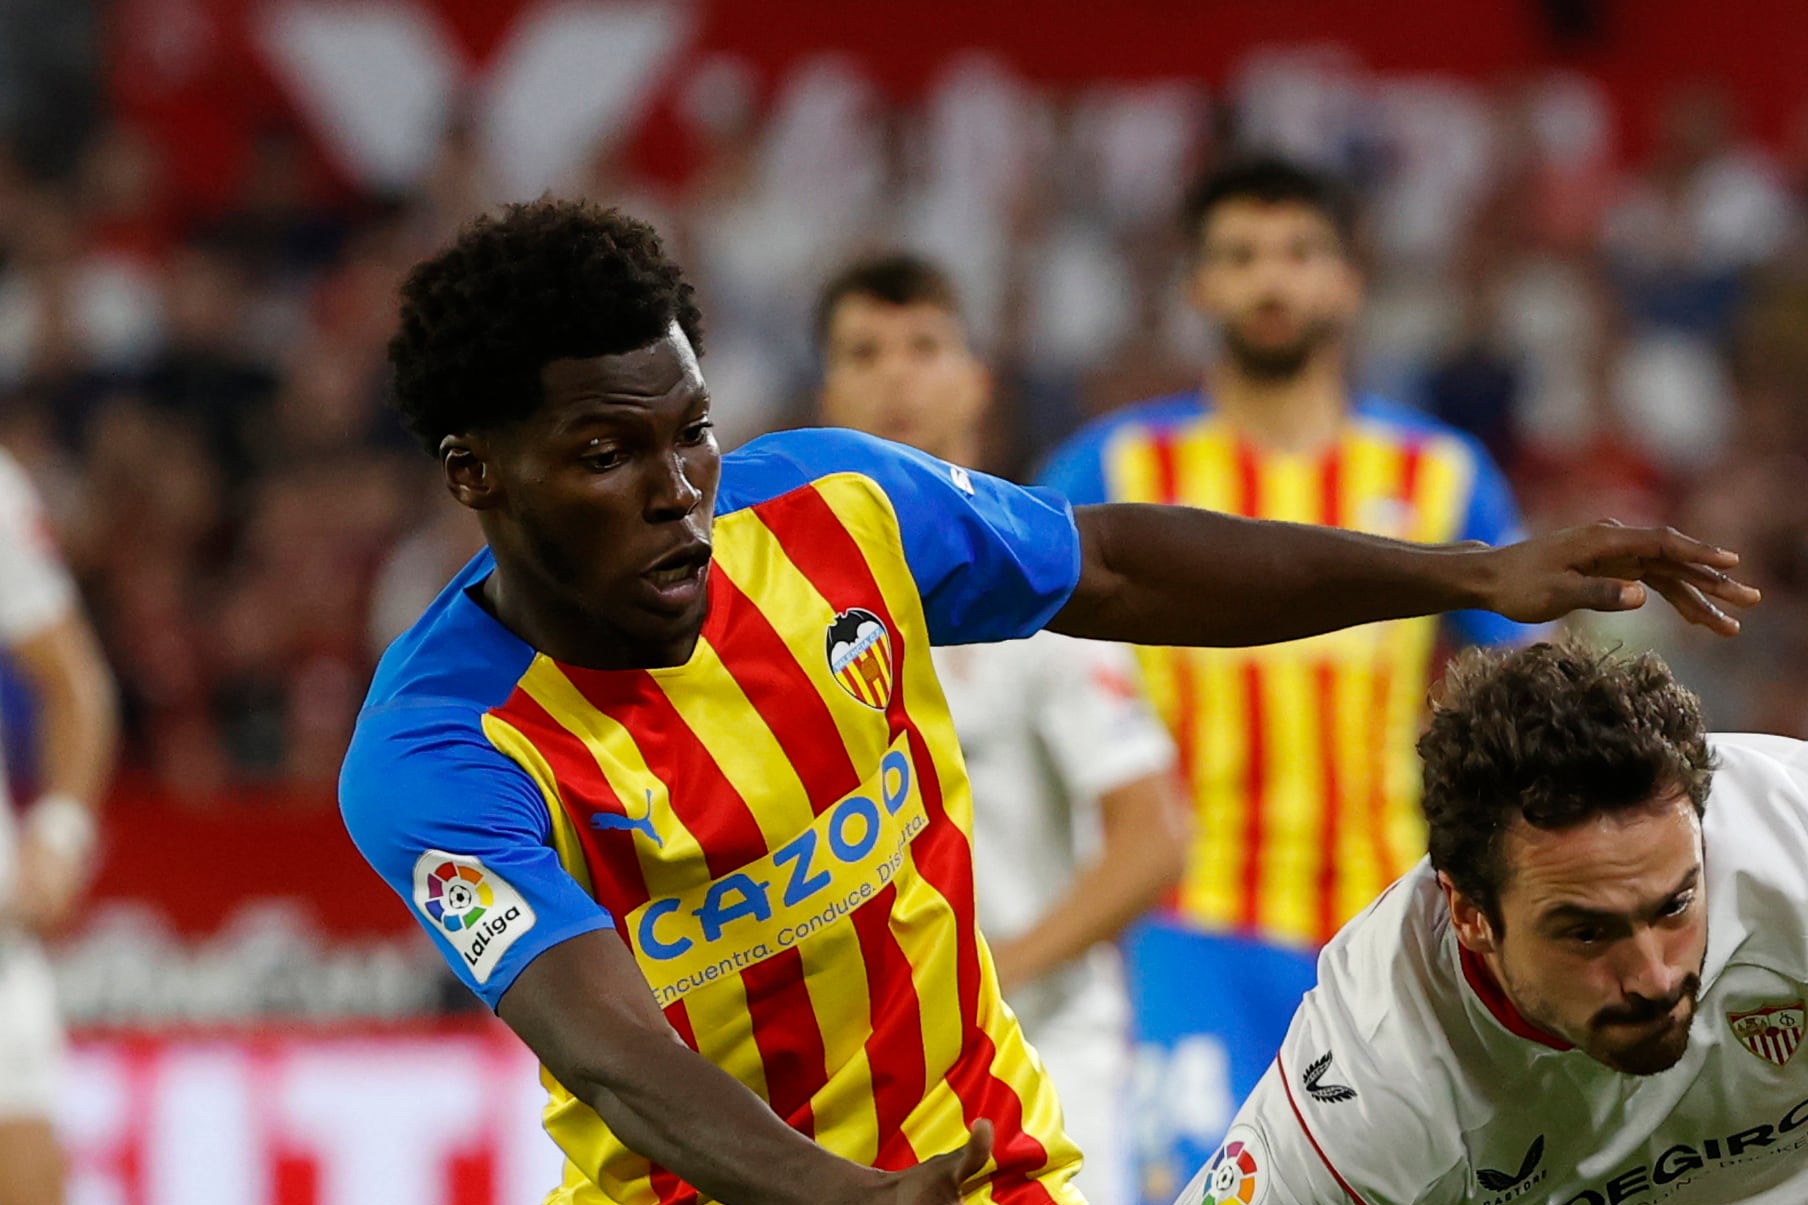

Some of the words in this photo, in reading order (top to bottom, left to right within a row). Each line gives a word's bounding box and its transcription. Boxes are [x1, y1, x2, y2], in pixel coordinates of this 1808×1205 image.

[638, 750, 909, 961] CAZOO
[464, 906, 521, 966] LaLiga
[777, 881, 876, 947] Conduce.
